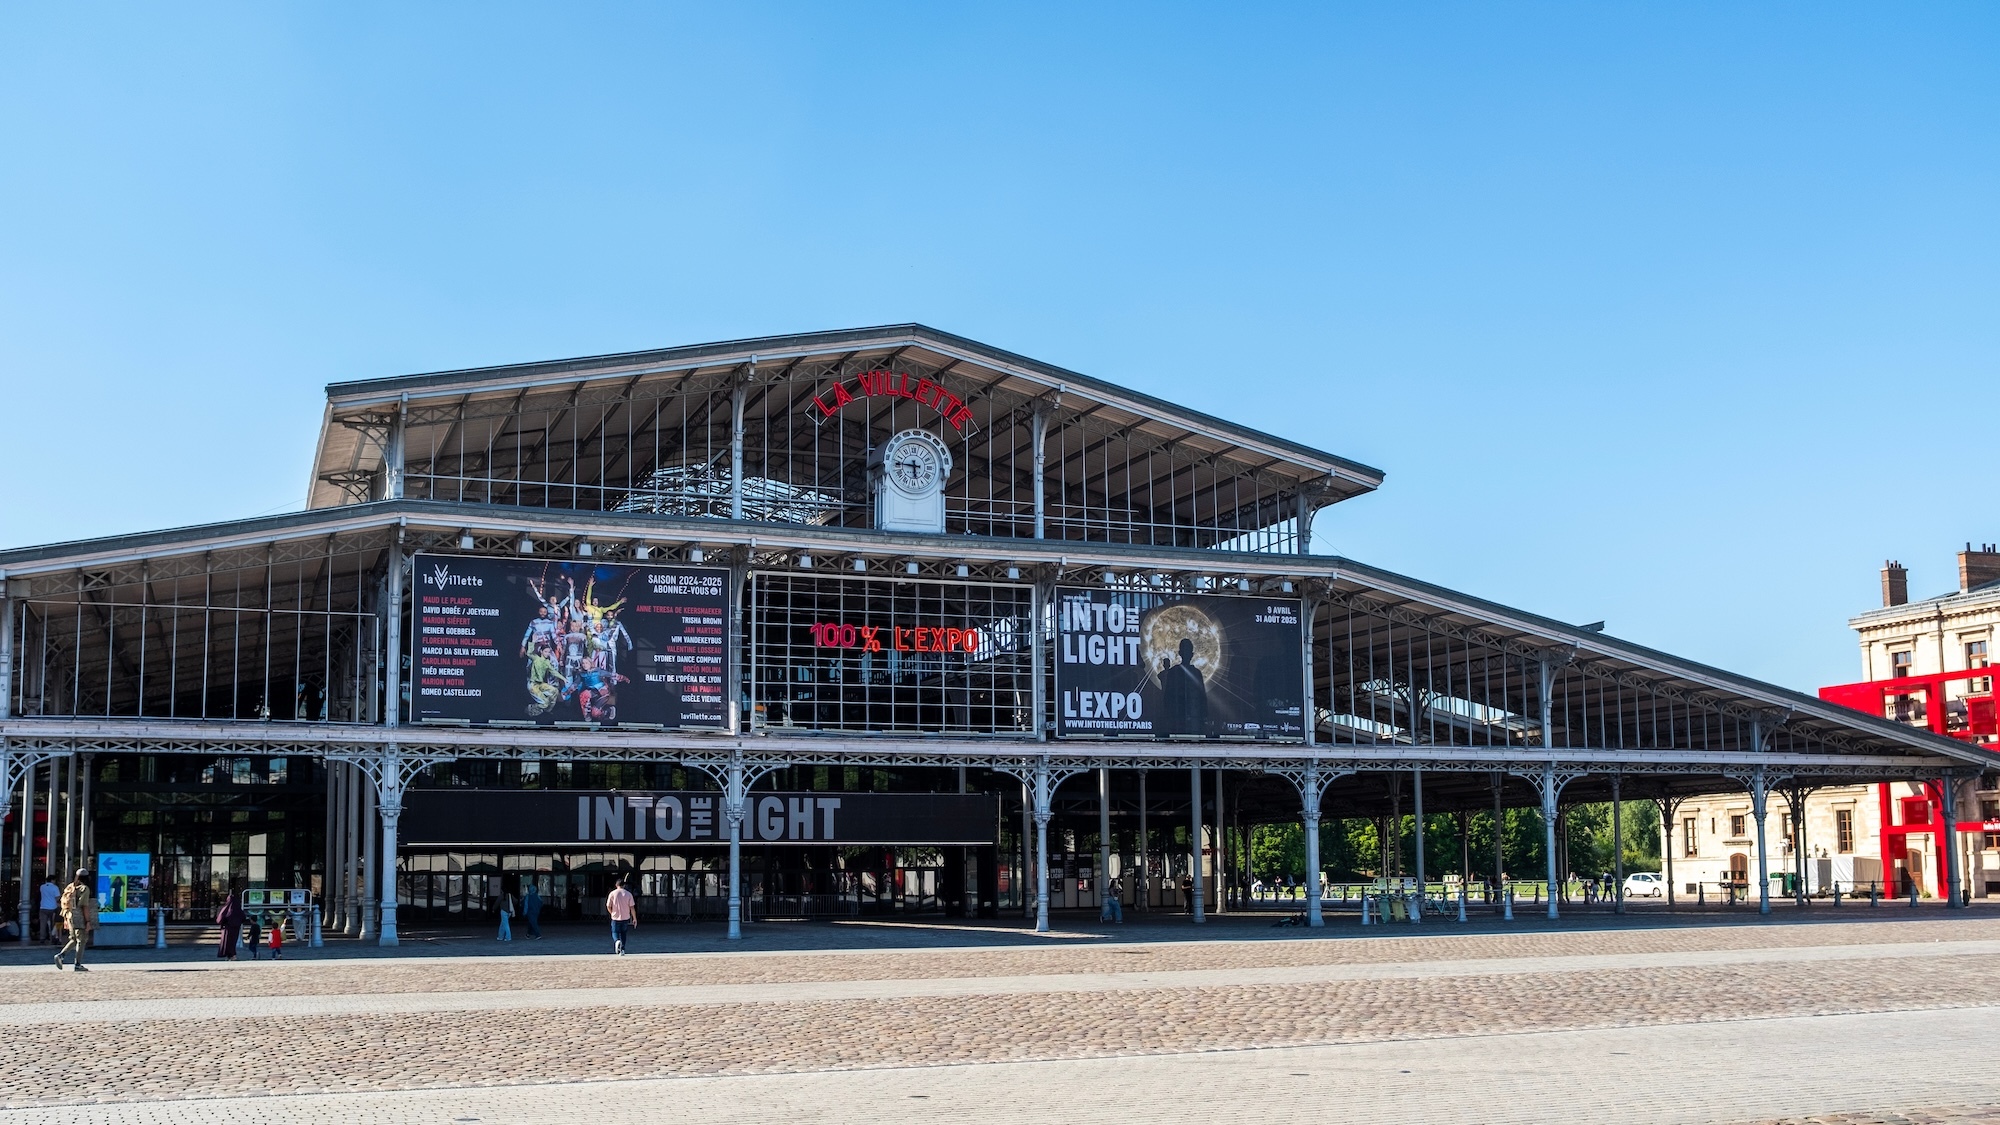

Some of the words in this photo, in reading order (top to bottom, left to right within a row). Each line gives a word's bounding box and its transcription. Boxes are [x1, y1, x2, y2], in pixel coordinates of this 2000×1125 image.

[813, 382, 853, 417] LA
[858, 371, 973, 430] VILLETTE
[648, 574, 676, 584] SAISON
[679, 576, 722, 586] 2024-2025
[654, 585, 709, 595] ABONNEZ-VOUS
[442, 606, 461, 614] BOBÉE
[467, 608, 499, 616] JOEYSTARR
[684, 607, 722, 615] KEERSMAEKER
[447, 616, 470, 625] SIÉFERT
[1063, 602, 1125, 633] INTO
[1126, 606, 1140, 633] THE
[1281, 616, 1297, 624] 2025
[460, 638, 492, 646] HOLZINGER
[810, 622, 856, 648] 100
[861, 625, 880, 652] %
[895, 626, 978, 652] L'EXPO
[1063, 634, 1141, 665] LIGHT
[422, 666, 437, 675] THÉO
[681, 694, 700, 702] GISÈLE
[1064, 686, 1143, 720] L'EXPO
[1065, 720, 1152, 729] WWW.INTOTHELIGHT.PARIS
[578, 796, 683, 841] INTO
[690, 797, 711, 839] THE
